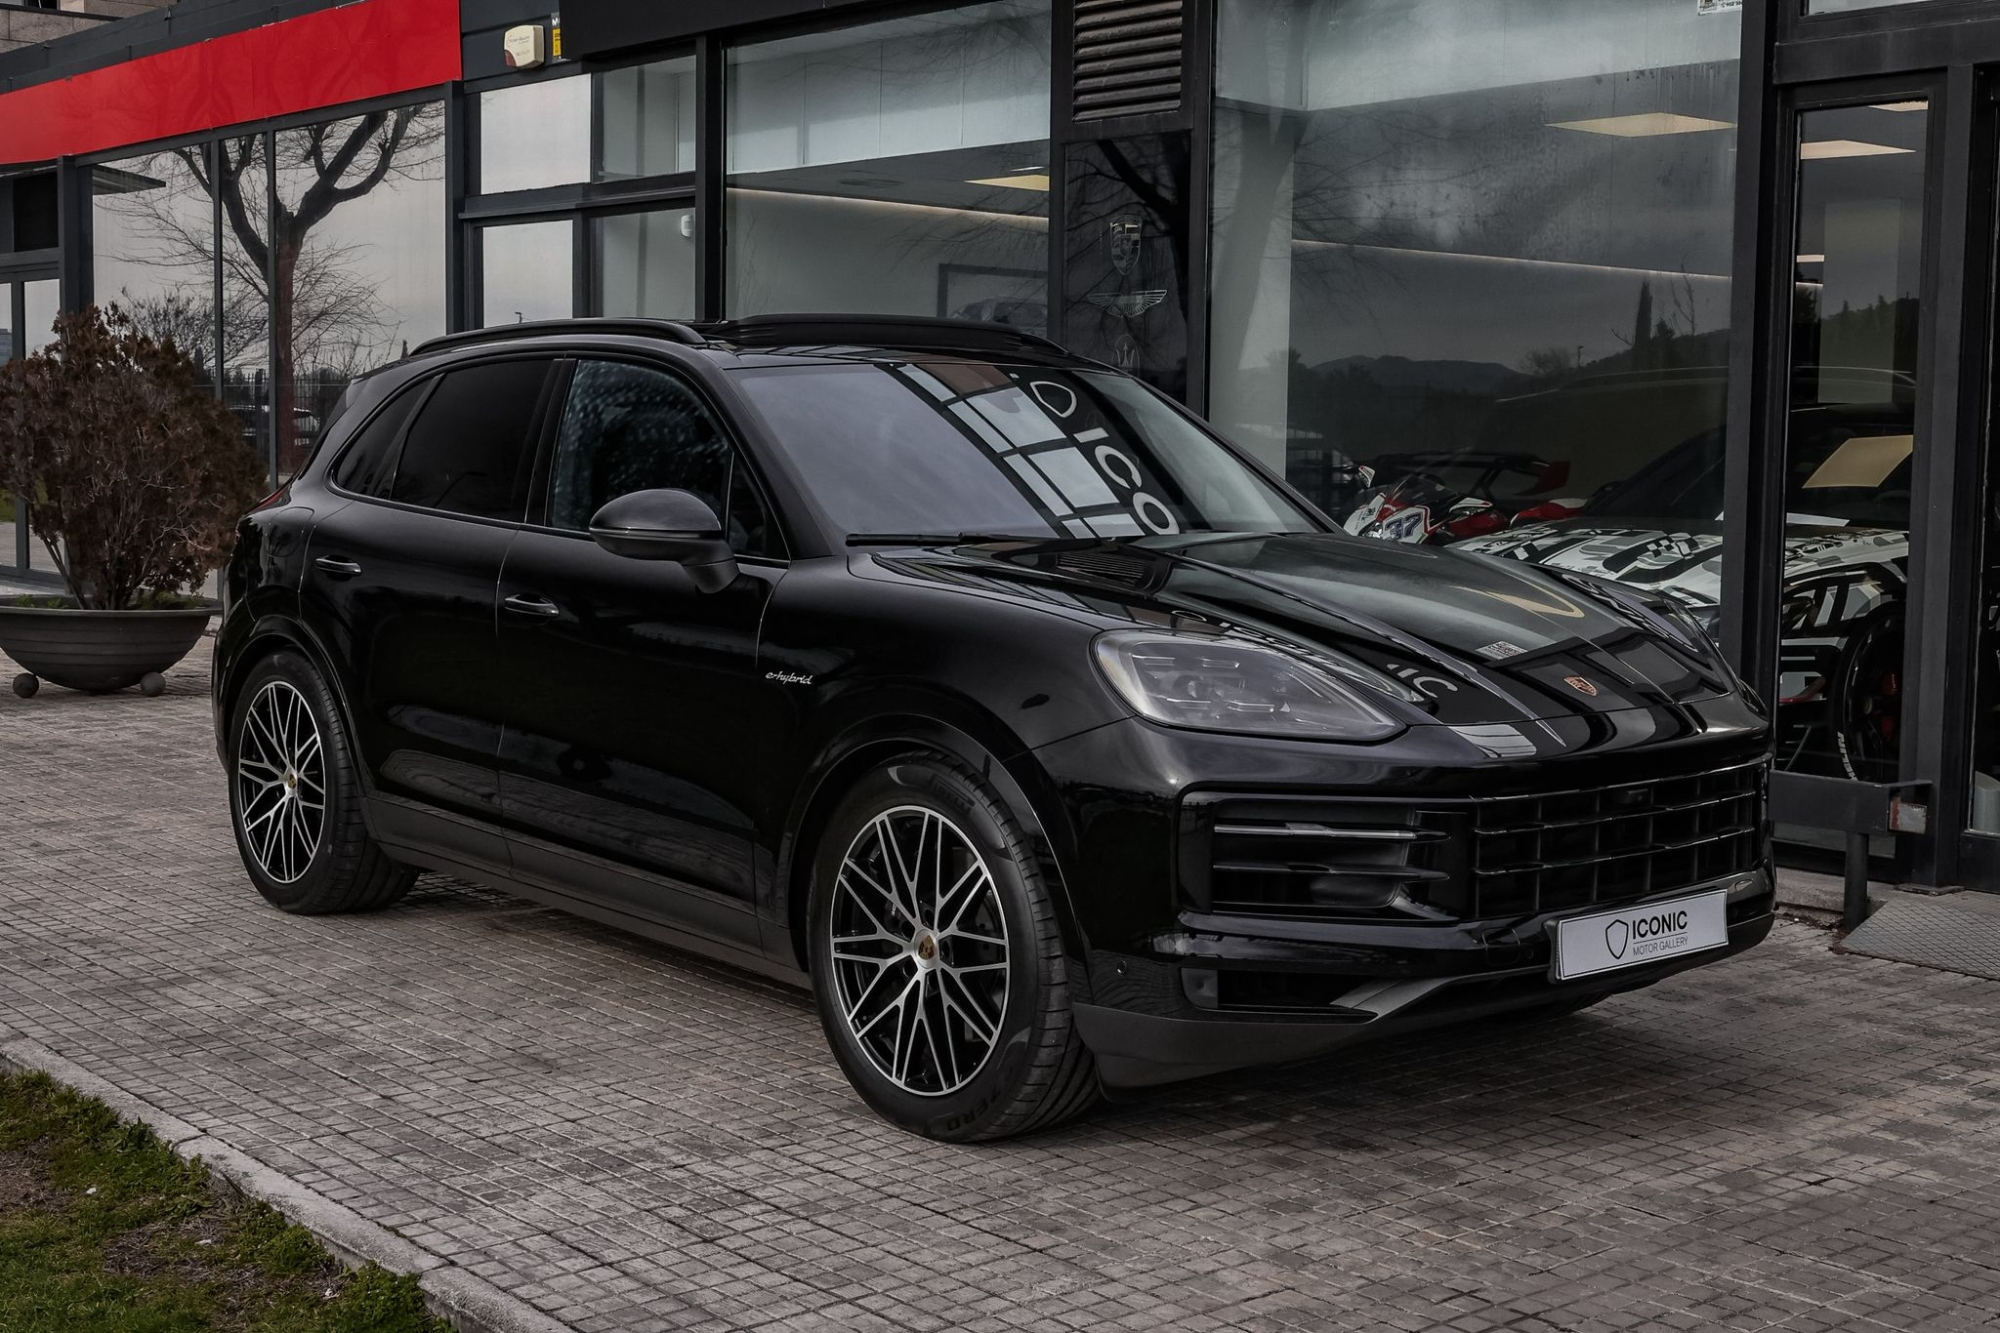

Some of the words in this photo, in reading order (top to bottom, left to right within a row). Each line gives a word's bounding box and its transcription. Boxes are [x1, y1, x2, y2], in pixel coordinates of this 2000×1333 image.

[1384, 511, 1423, 539] 37
[1632, 910, 1688, 940] ICONIC
[1632, 943, 1659, 956] MOTOR
[1658, 937, 1689, 952] GALLERY
